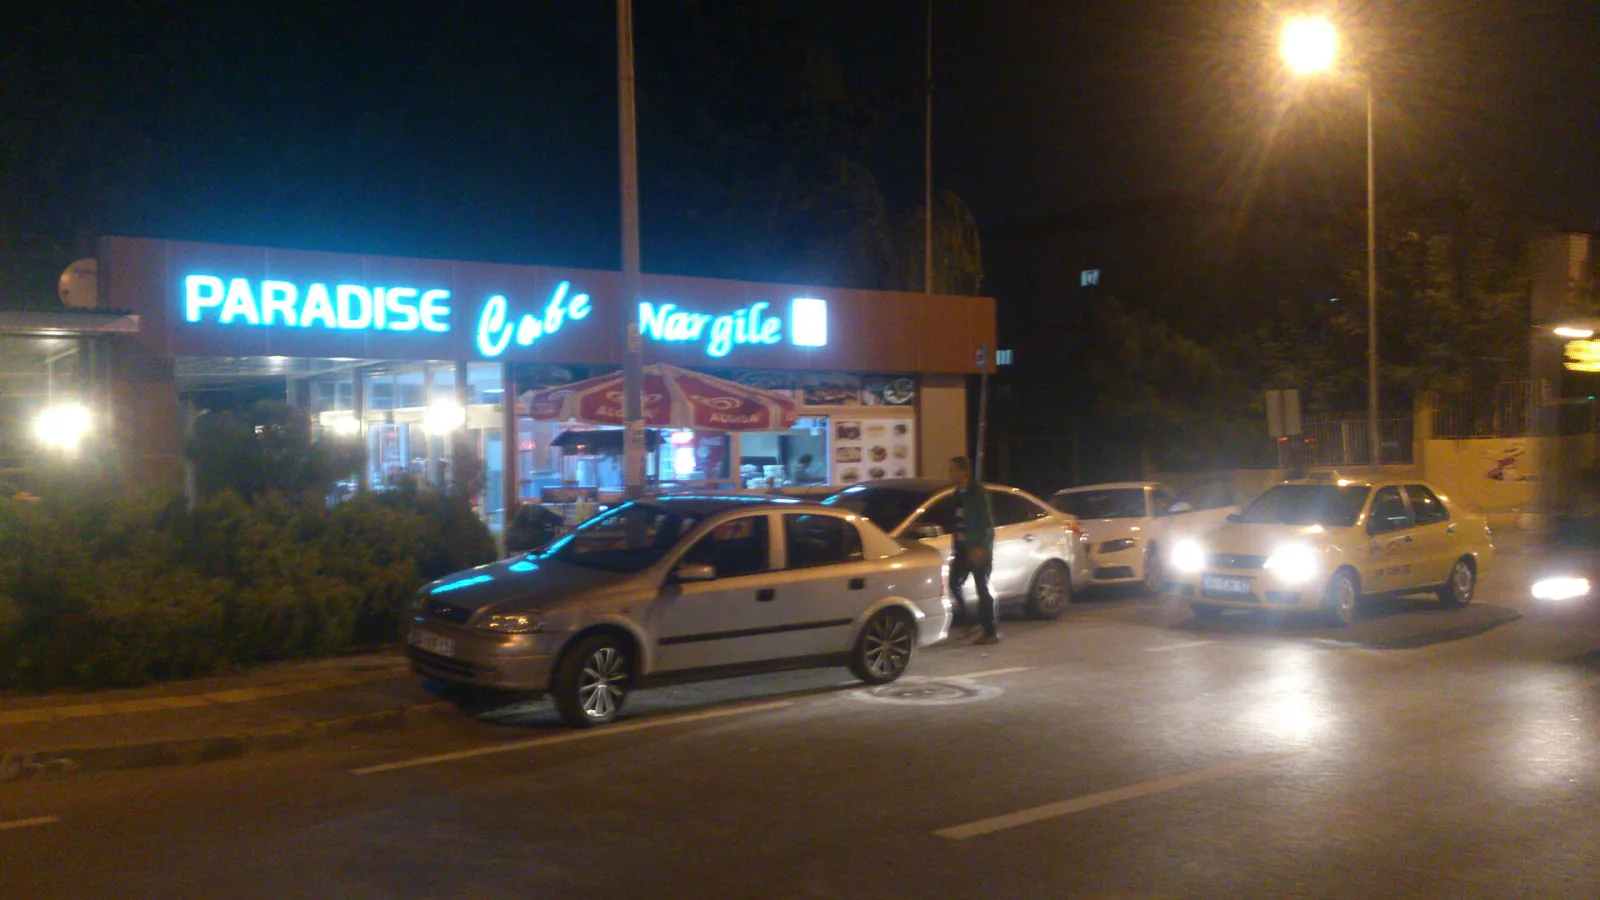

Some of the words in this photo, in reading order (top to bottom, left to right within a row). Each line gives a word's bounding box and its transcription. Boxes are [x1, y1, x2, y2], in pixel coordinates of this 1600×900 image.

[184, 274, 452, 333] PARADISE
[477, 281, 591, 357] Cafe
[639, 301, 782, 358] Nargile
